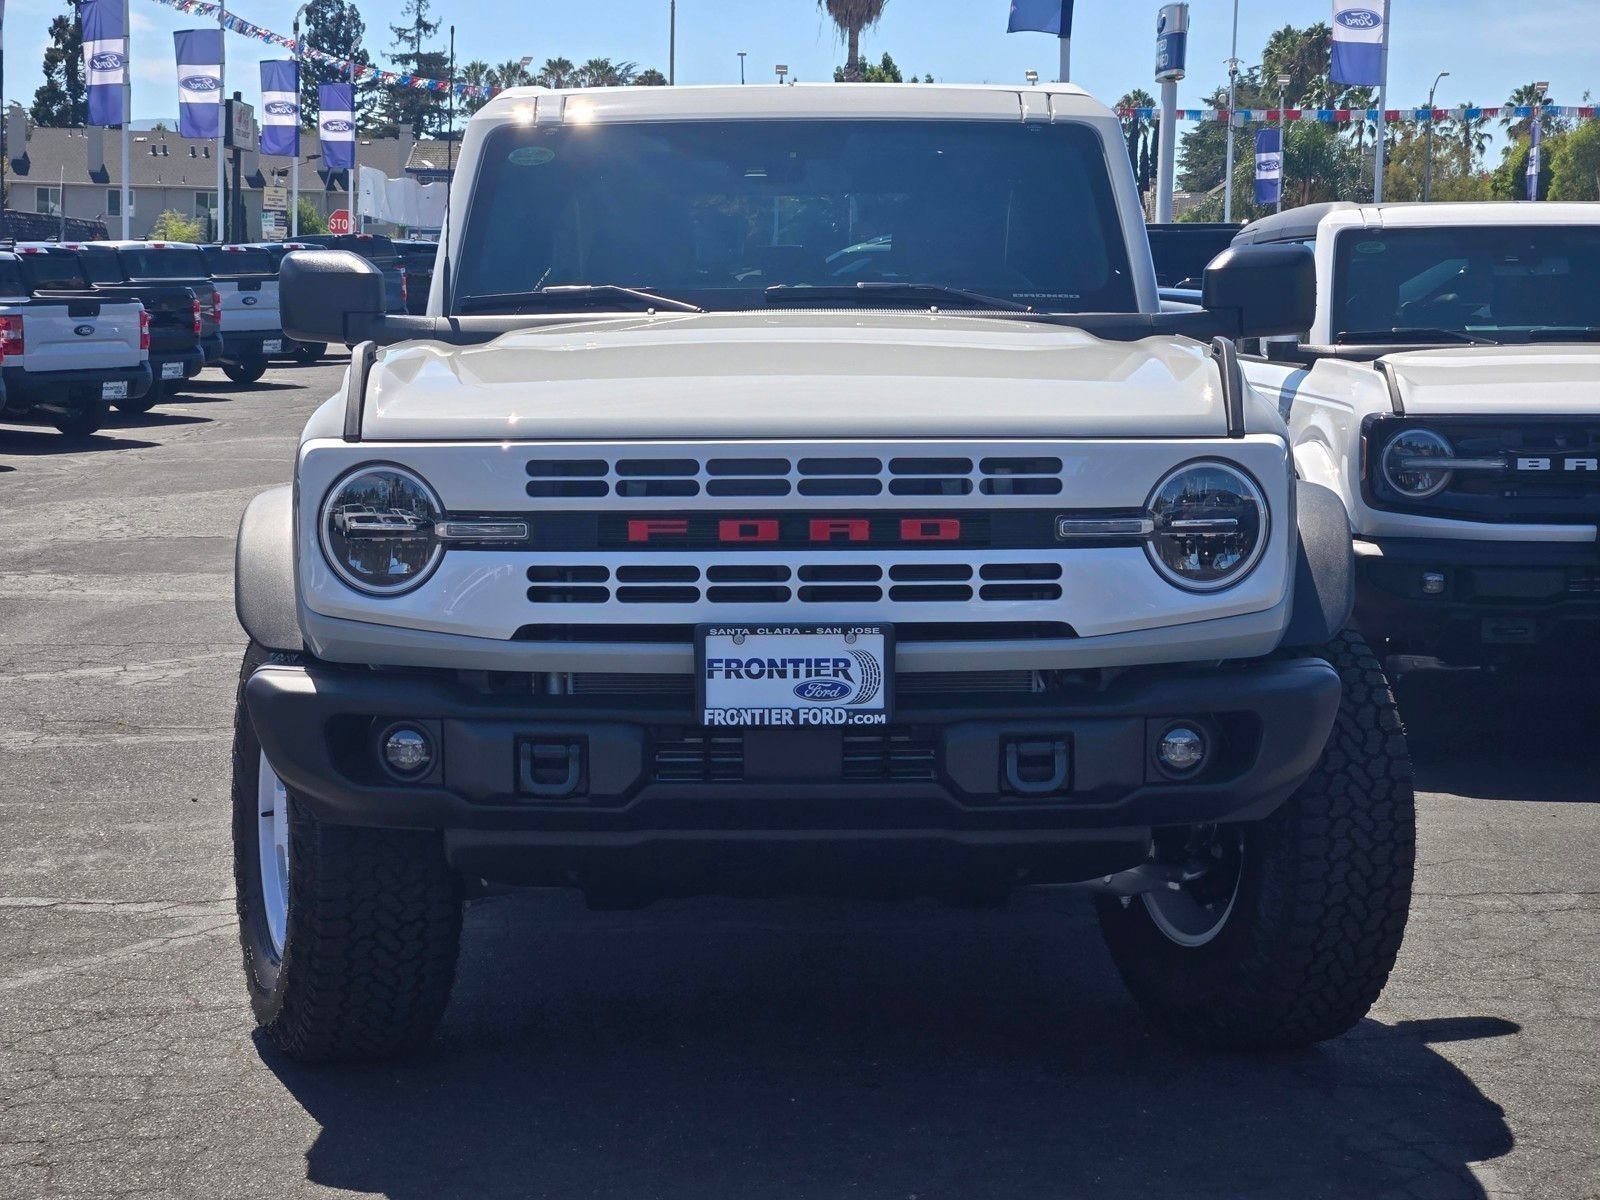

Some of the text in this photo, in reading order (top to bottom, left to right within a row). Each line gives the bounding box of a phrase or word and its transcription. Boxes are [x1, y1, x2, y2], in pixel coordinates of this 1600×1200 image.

[330, 218, 353, 230] STO
[628, 519, 960, 541] FORD
[707, 658, 856, 685] FRONTIER
[804, 683, 841, 697] Ford
[704, 708, 795, 725] FRONTIER
